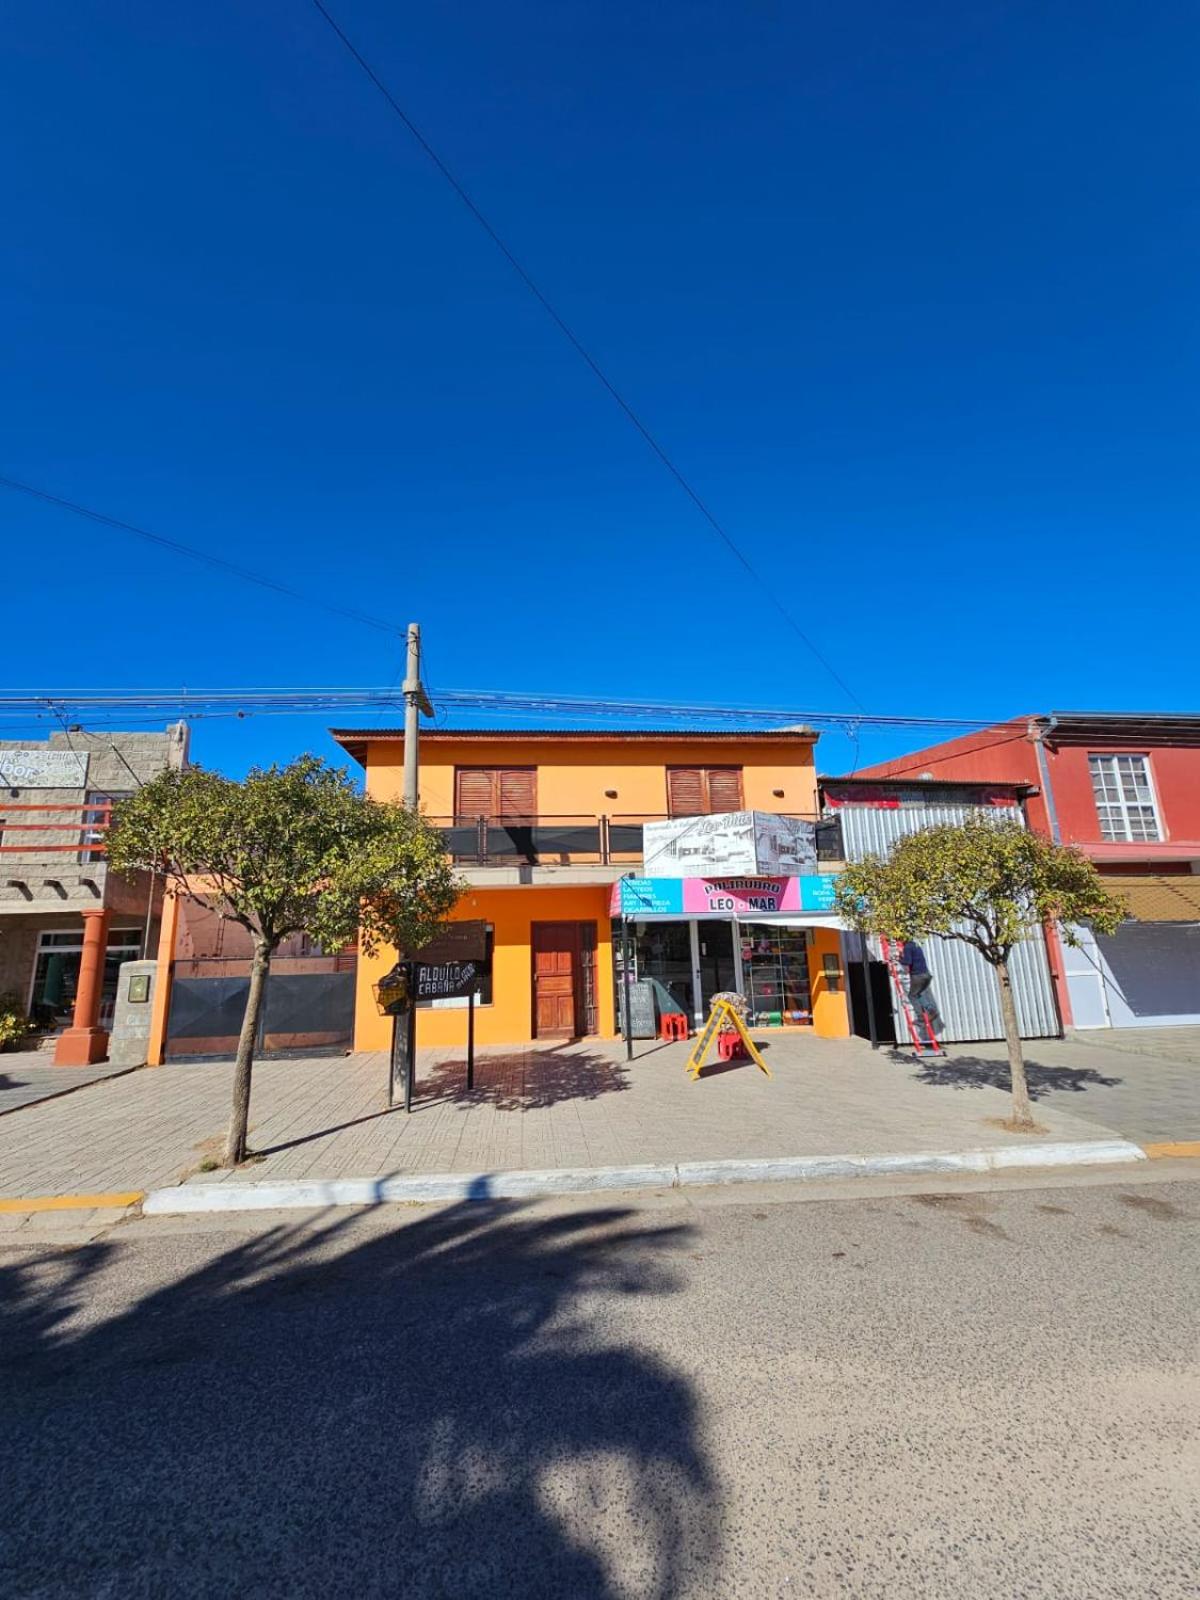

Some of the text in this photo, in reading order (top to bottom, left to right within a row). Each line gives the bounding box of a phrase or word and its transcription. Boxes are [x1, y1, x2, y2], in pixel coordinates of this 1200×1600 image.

[704, 880, 781, 895] POLIRUBRO
[709, 897, 735, 911] LEO
[748, 897, 776, 911] MAR
[419, 966, 461, 982] ALQUILO
